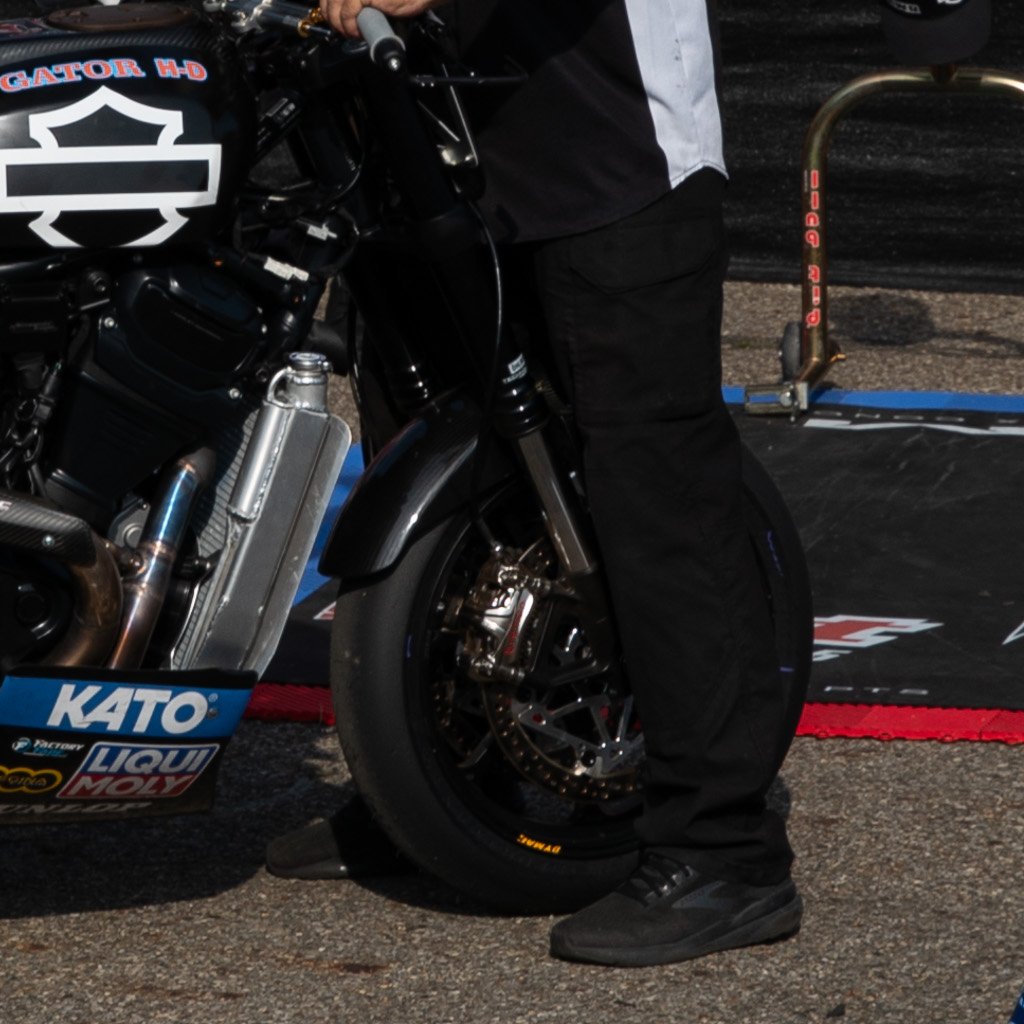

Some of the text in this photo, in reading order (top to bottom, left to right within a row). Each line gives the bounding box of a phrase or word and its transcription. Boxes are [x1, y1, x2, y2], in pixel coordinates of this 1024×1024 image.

[154, 57, 208, 81] H-D
[46, 683, 208, 735] KATO
[87, 746, 209, 775] LIQUI
[67, 775, 195, 797] MOLY
